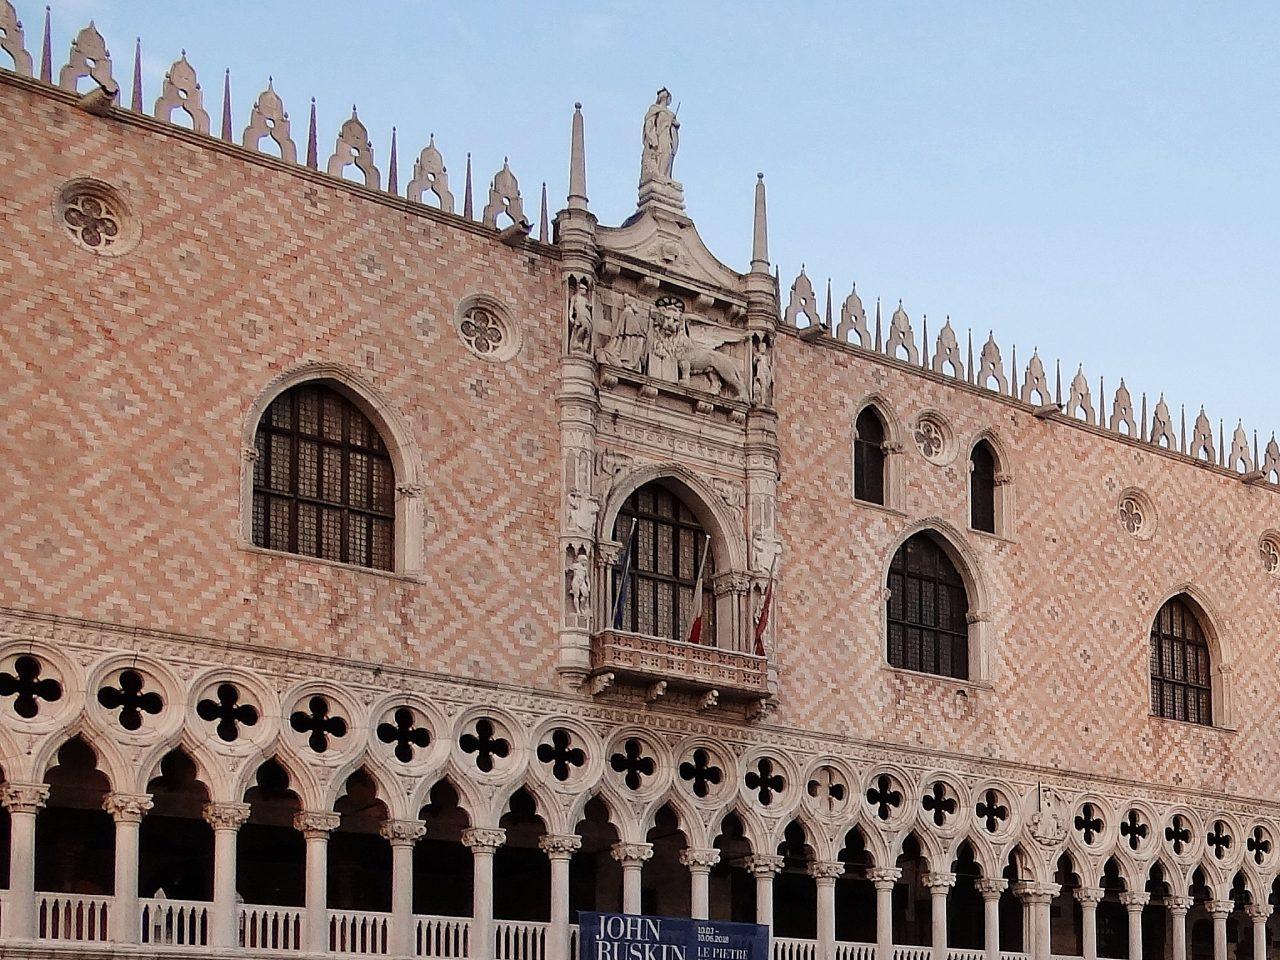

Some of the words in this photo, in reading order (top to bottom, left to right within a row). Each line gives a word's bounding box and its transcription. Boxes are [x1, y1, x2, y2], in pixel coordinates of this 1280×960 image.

[596, 915, 662, 941] JOHN
[697, 946, 710, 958] LE
[712, 947, 748, 960] PIETRE
